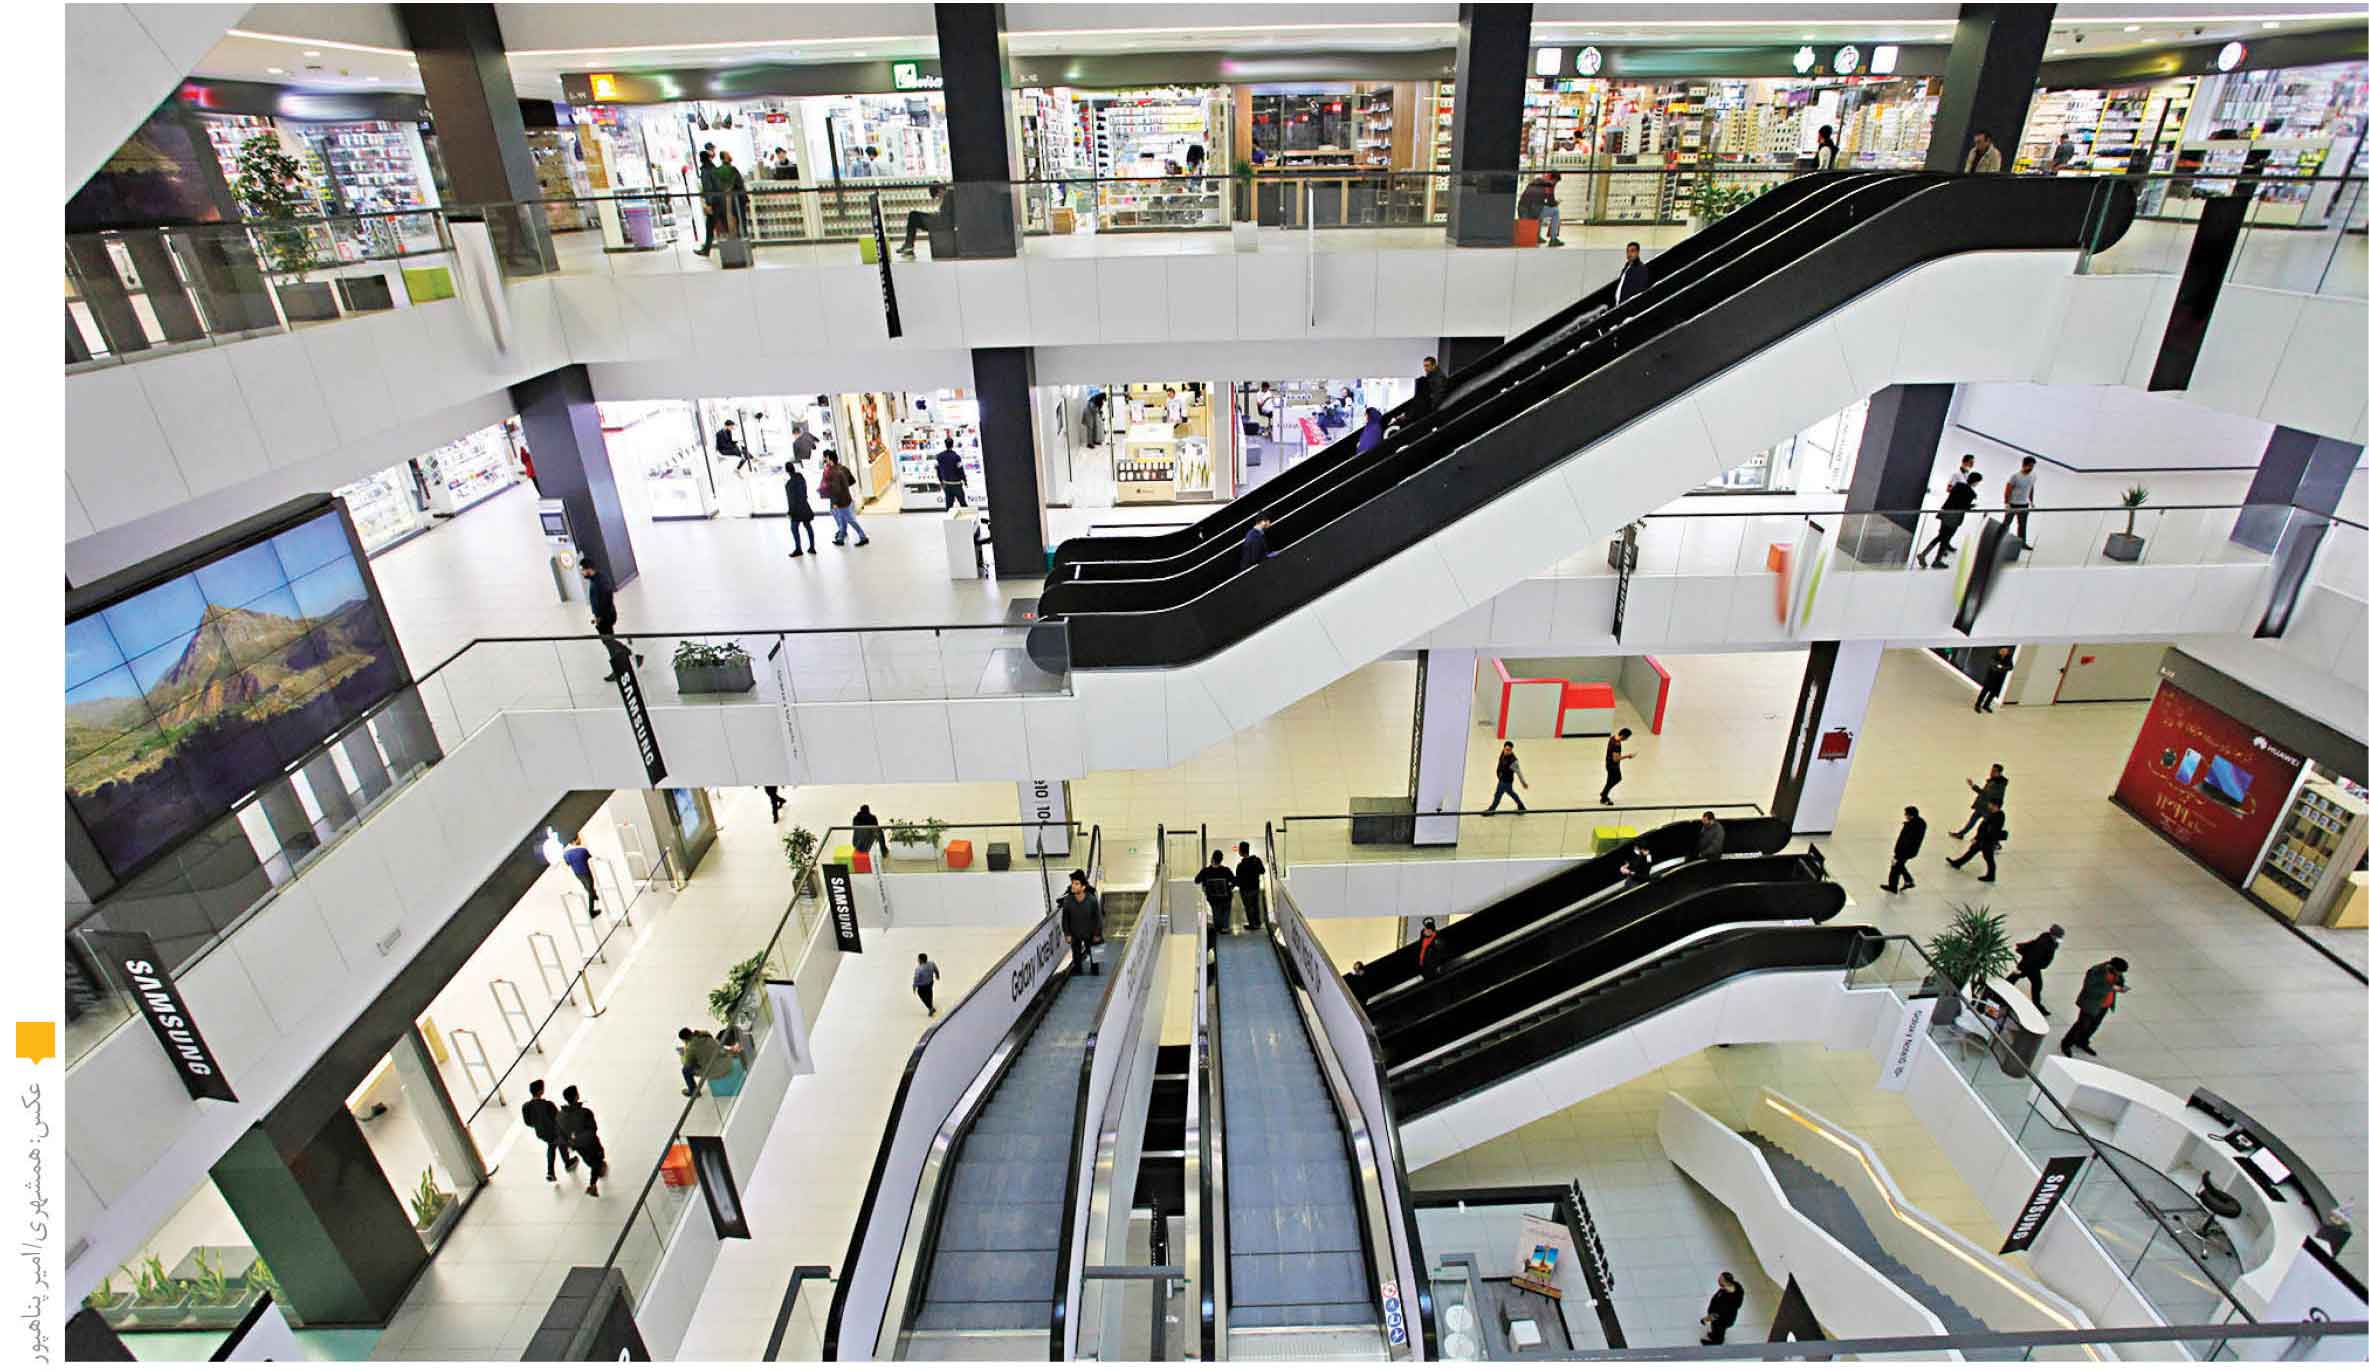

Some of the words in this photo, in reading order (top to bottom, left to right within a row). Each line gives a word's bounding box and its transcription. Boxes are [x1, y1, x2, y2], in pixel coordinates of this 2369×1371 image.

[620, 671, 655, 766] SAMSUNG
[2267, 745, 2300, 767] HUAWEI
[830, 876, 854, 938] SAMSUNG
[125, 959, 211, 1075] SAMSUNG
[2012, 1173, 2065, 1240] SAMSUNG
